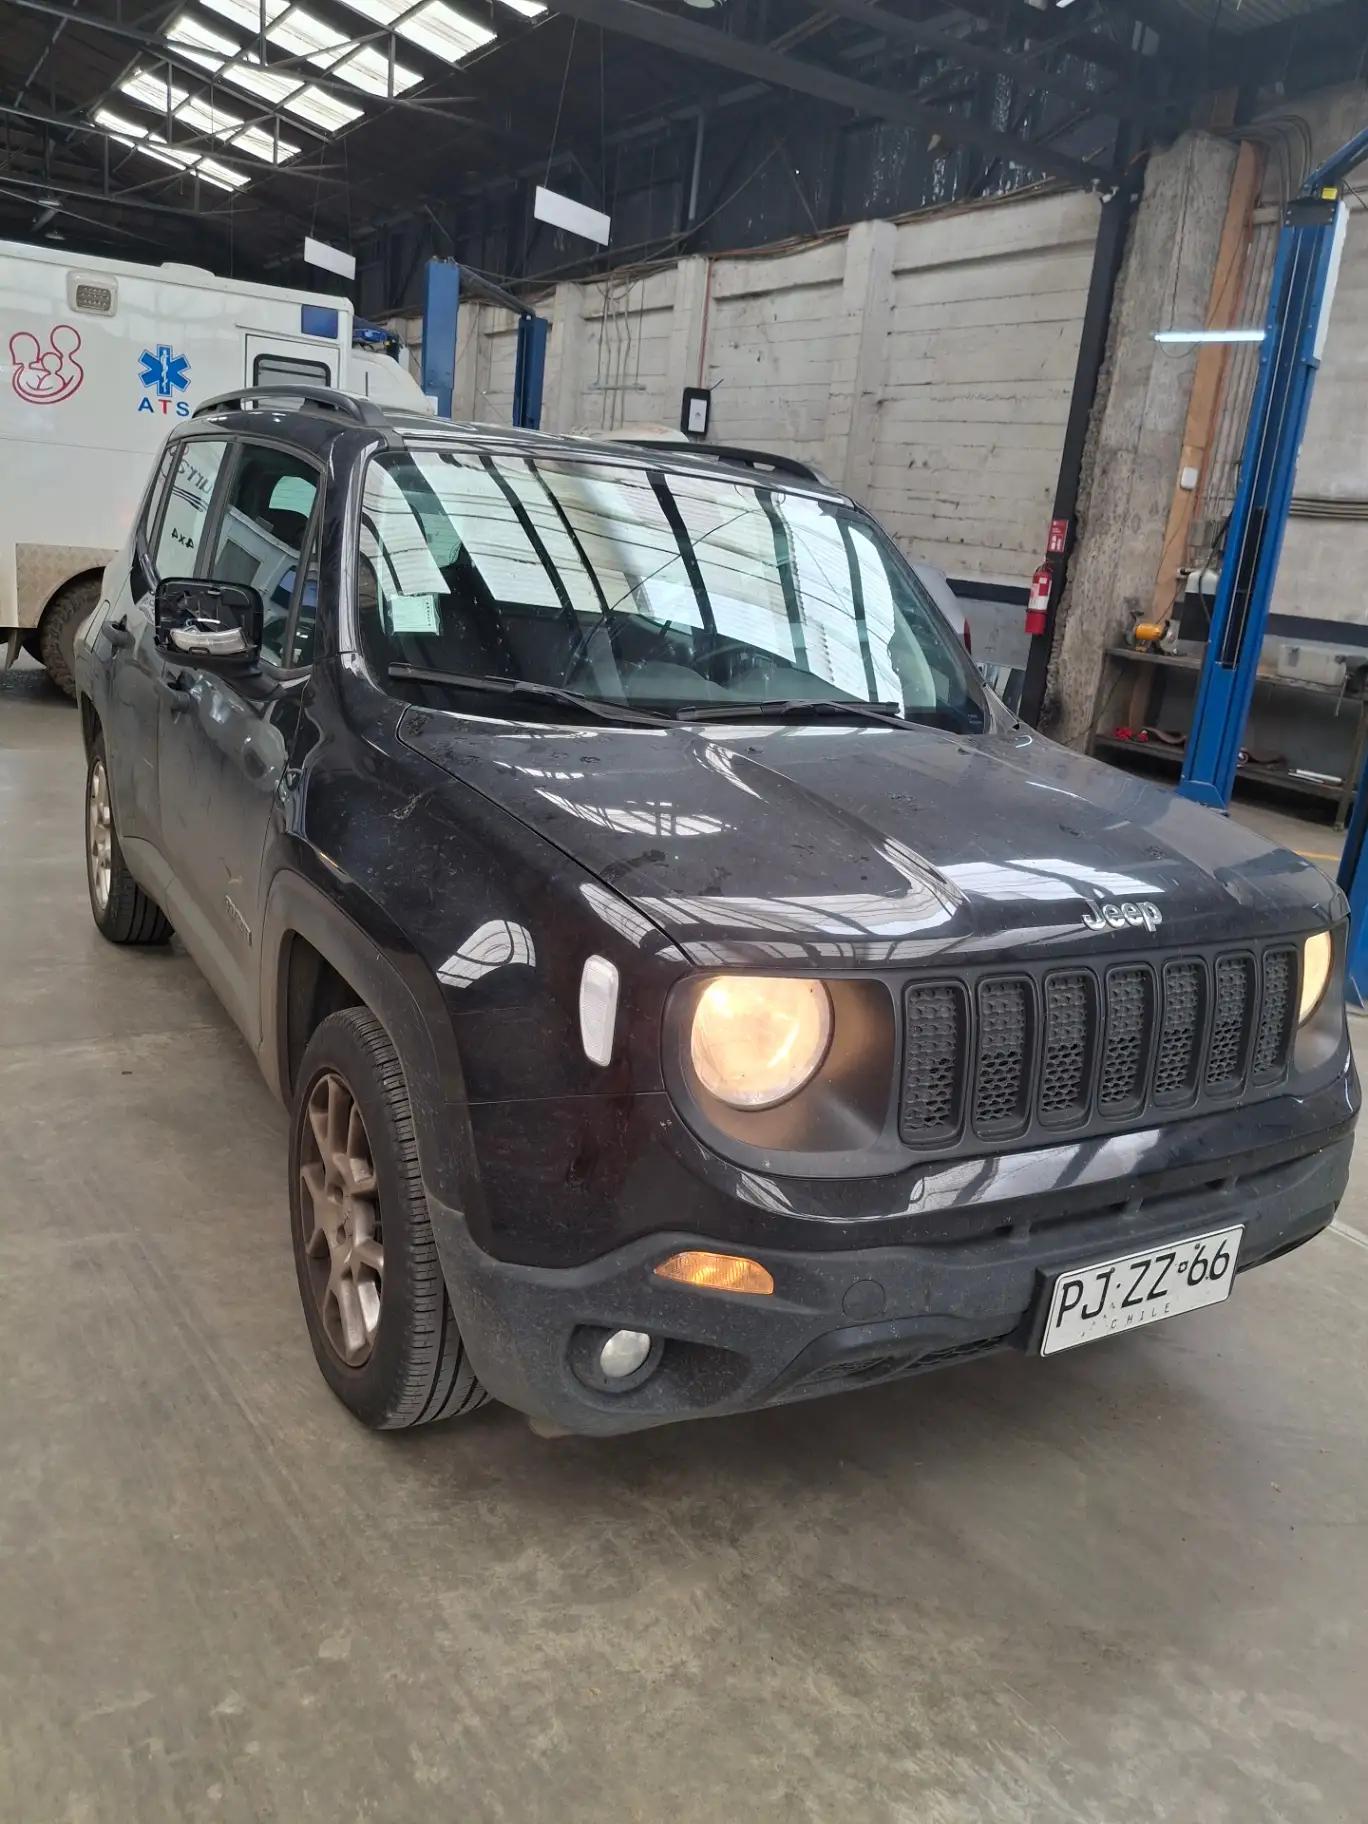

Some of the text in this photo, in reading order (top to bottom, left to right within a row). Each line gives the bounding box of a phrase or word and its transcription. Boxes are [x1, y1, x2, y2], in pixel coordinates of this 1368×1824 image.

[138, 397, 190, 417] ATS
[1082, 900, 1162, 931] Jeep
[1111, 1302, 1170, 1329] CHILE
